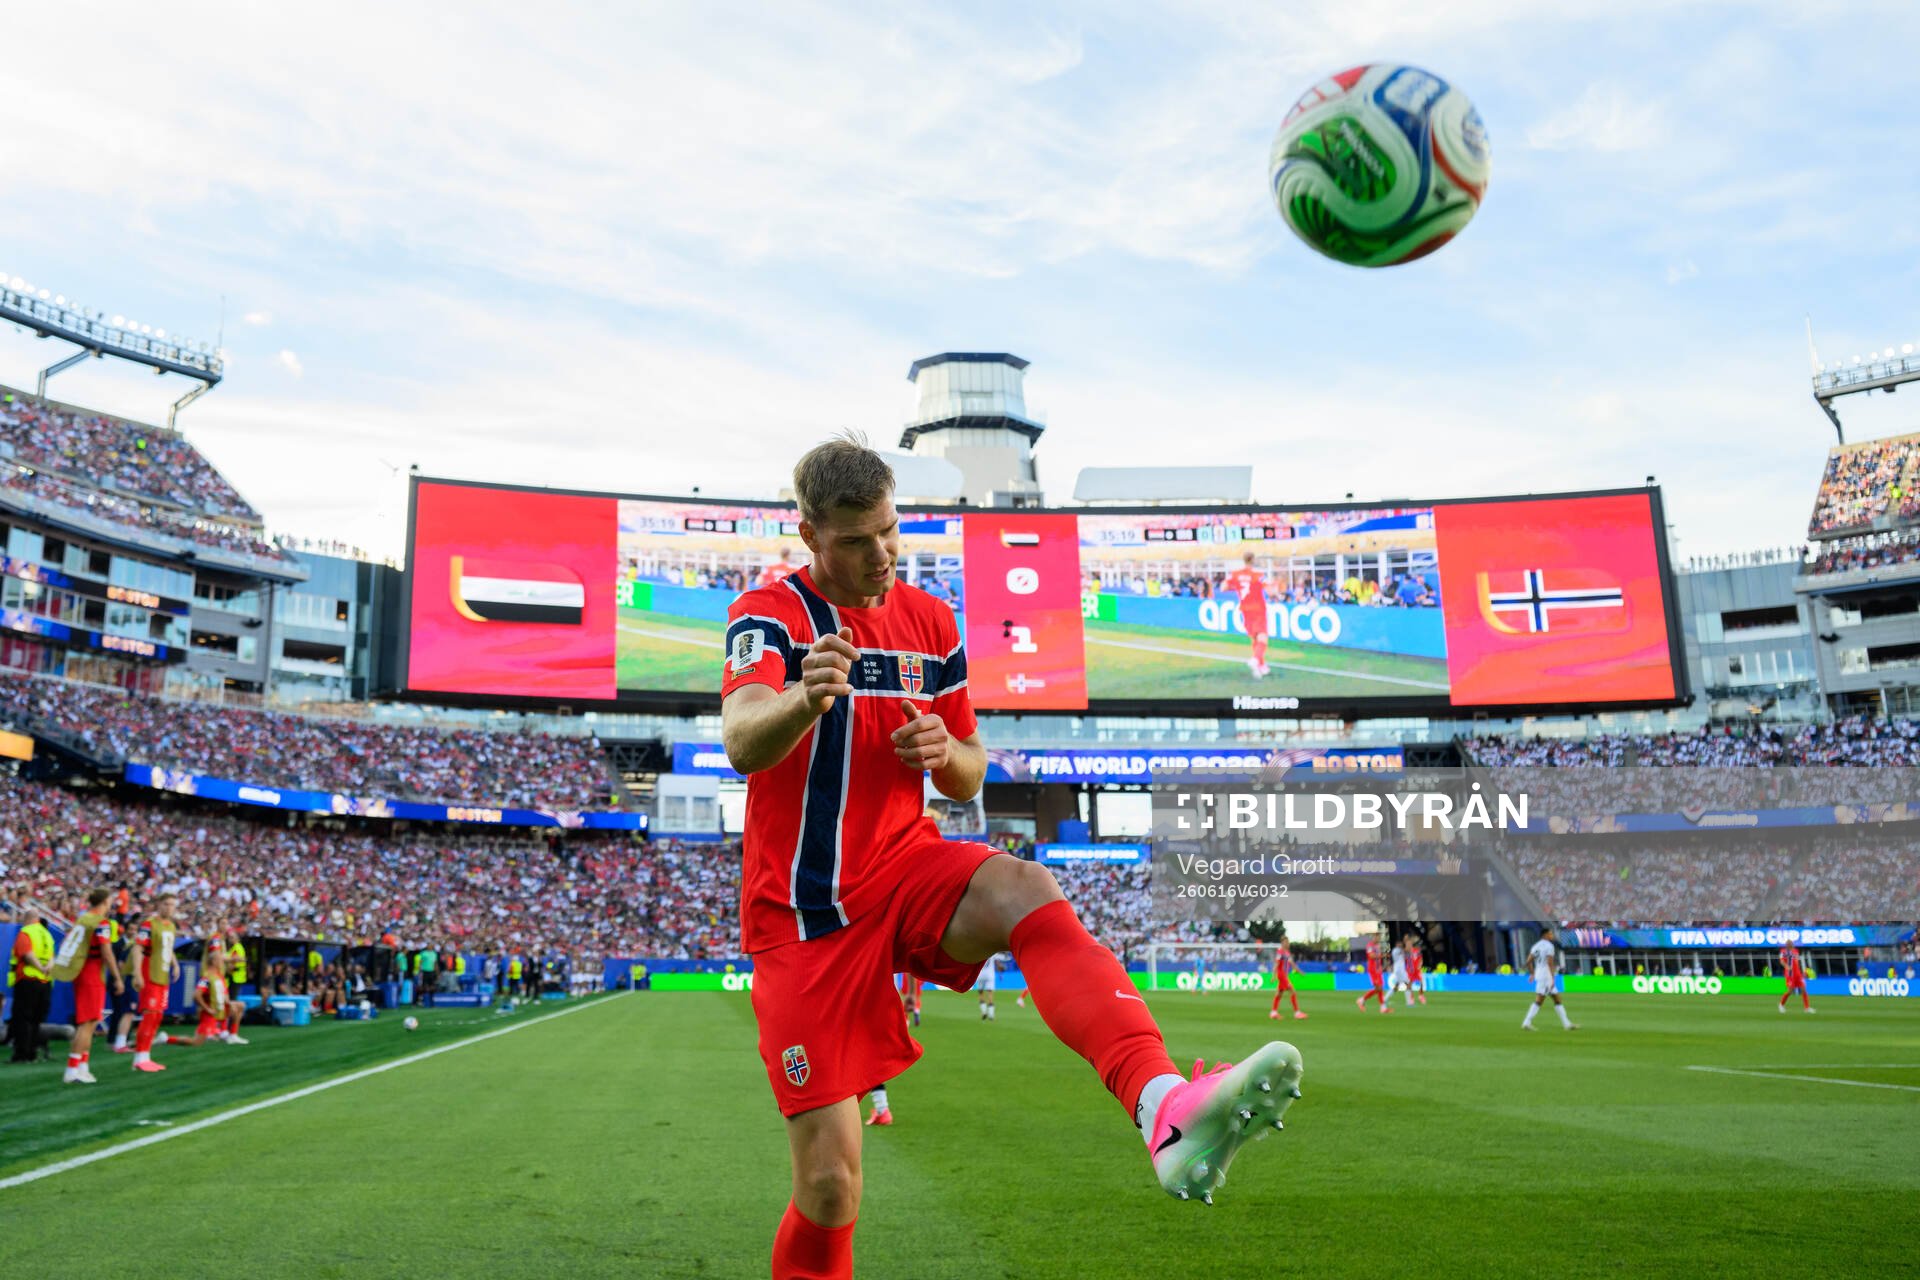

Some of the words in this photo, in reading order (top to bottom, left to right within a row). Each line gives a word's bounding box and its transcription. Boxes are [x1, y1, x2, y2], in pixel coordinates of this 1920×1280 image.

[1006, 567, 1039, 594] 0
[1011, 626, 1038, 653] 1
[1233, 696, 1299, 709] Hisense
[1029, 757, 1073, 775] FIFA
[1073, 757, 1146, 774] WORLD
[1148, 757, 1189, 774] CUP
[1312, 755, 1402, 773] BOSTON
[1670, 931, 1706, 945] FIFA
[1707, 931, 1765, 945] WORLD
[1766, 930, 1801, 944] CUP
[1632, 975, 1722, 994] aramco
[1849, 977, 1909, 997] aramco
